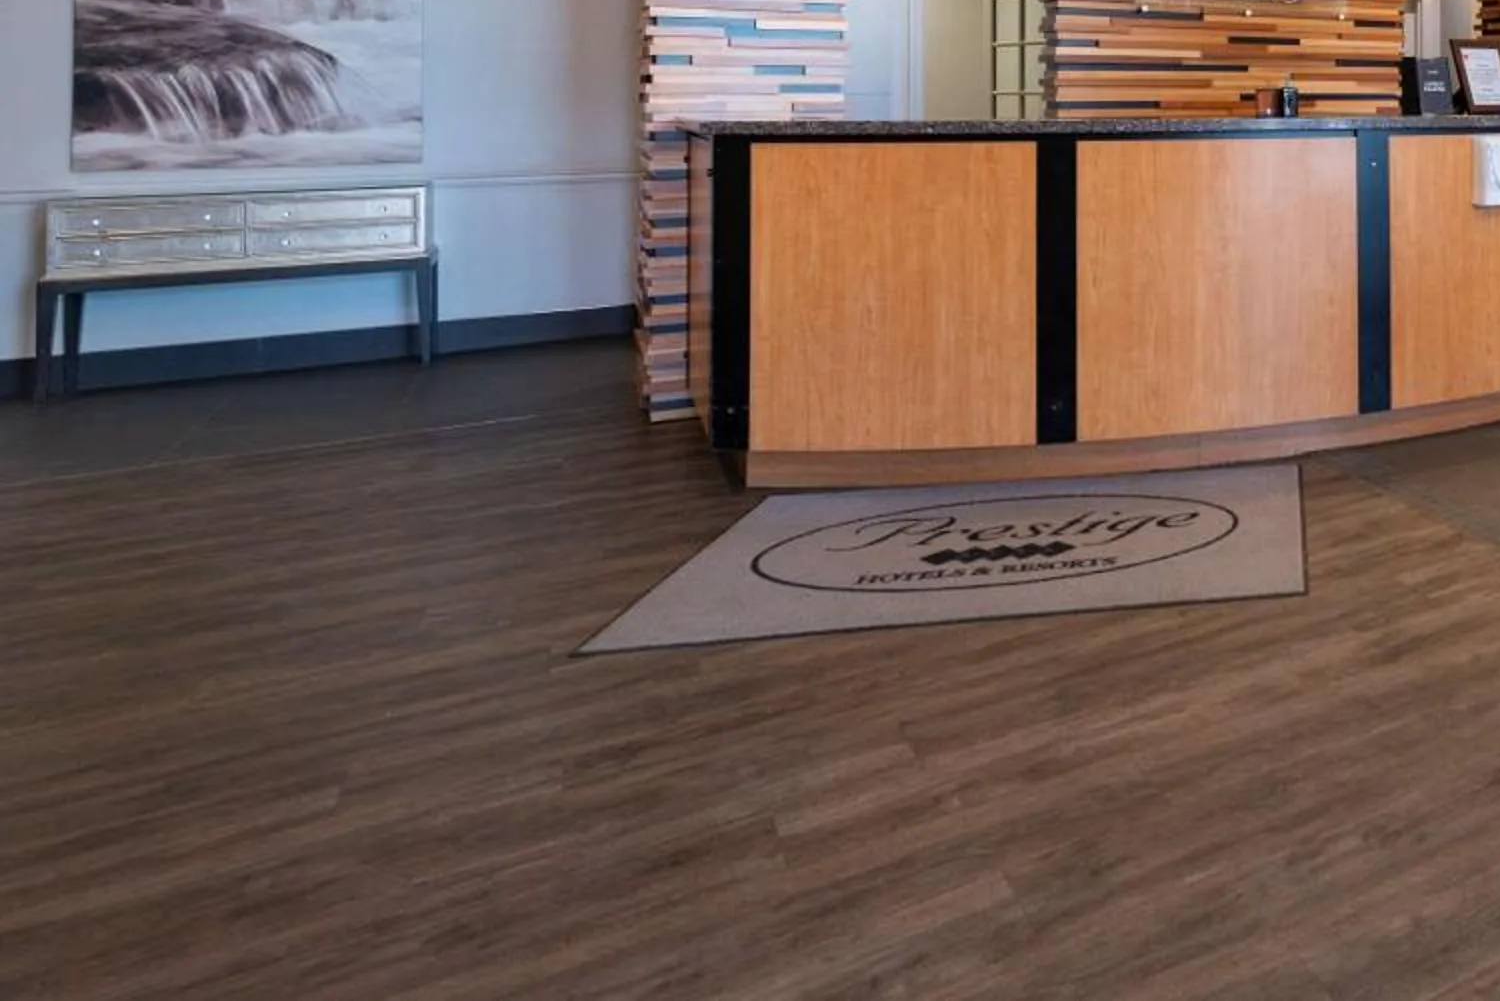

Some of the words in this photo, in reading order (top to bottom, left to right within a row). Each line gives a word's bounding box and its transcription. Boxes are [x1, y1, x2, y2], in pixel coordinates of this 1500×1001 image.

[824, 510, 1200, 551] Prestige
[856, 568, 964, 585] HOTELS
[969, 566, 992, 576] &
[1000, 555, 1120, 574] RESORTS
